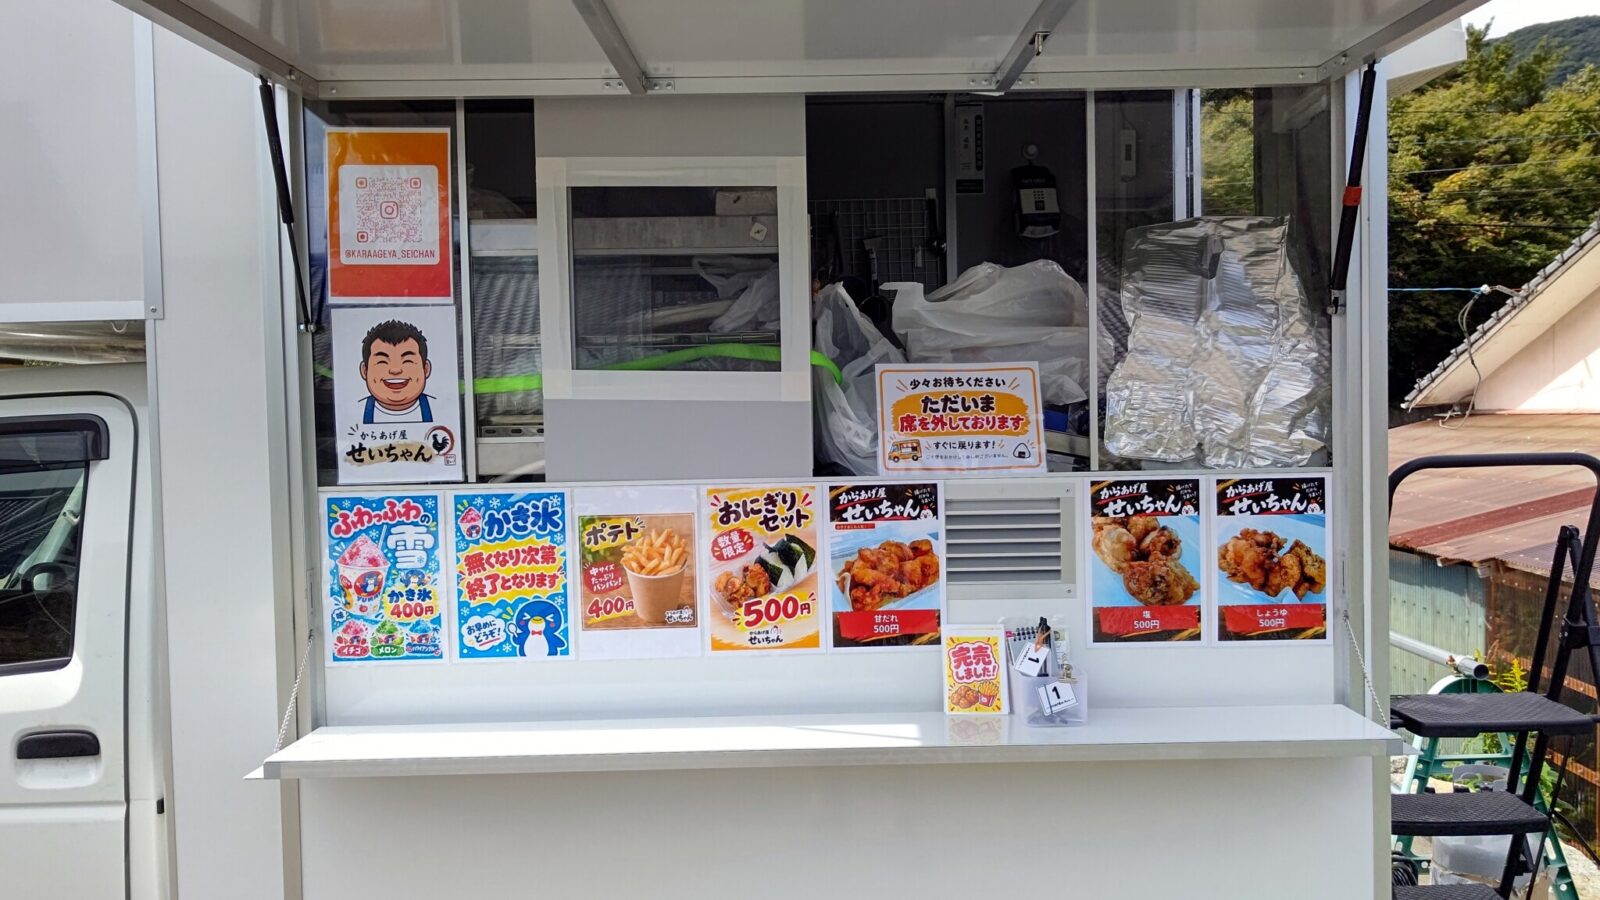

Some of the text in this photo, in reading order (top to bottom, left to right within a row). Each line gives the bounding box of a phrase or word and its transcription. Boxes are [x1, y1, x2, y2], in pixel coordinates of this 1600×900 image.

[345, 250, 435, 260] @KARAAGEYA_SEICHAN
[910, 377, 1006, 390] 少々お待ちください
[922, 394, 994, 414] ただいま
[900, 414, 1024, 432] 席を外しております
[360, 430, 408, 440] からあげ屋
[346, 442, 432, 462] せいちゃん
[838, 487, 887, 505] からあげ屋
[1100, 482, 1149, 500] からあげ屋
[1226, 481, 1274, 498] からあげ屋
[718, 492, 796, 525] おにぎり
[842, 500, 920, 522] せいちゃん
[1104, 495, 1182, 517] せいちゃん
[1229, 493, 1307, 515] せいちゃん
[334, 500, 430, 536] ふわっふわの
[485, 501, 562, 537] かき氷
[758, 510, 809, 532] セット
[586, 522, 638, 546] ポテト
[718, 532, 743, 548] 数量
[388, 525, 434, 569] 雪
[722, 543, 746, 559] 限定
[464, 546, 556, 574] 無くなり次第
[590, 564, 615, 576] 中サイズ
[466, 572, 559, 600] 終了となります
[592, 573, 614, 584] たっぷり
[388, 589, 432, 603] かき氷
[390, 602, 434, 618] 400円
[588, 597, 634, 618] 400円
[744, 596, 811, 627] 500円
[1142, 610, 1151, 618] 塩
[1257, 609, 1287, 617] しょうゆ
[874, 614, 898, 623] 甘だれ
[1134, 620, 1160, 629] 500円
[1259, 618, 1285, 627] 500円
[467, 620, 496, 634] お早めに
[874, 624, 899, 633] 500円
[748, 636, 783, 645] せいちゃん
[342, 646, 362, 654] イチゴ
[378, 646, 398, 654] メロン
[952, 646, 992, 670] 完売
[1028, 656, 1040, 664] 1
[1052, 686, 1061, 700] 1
